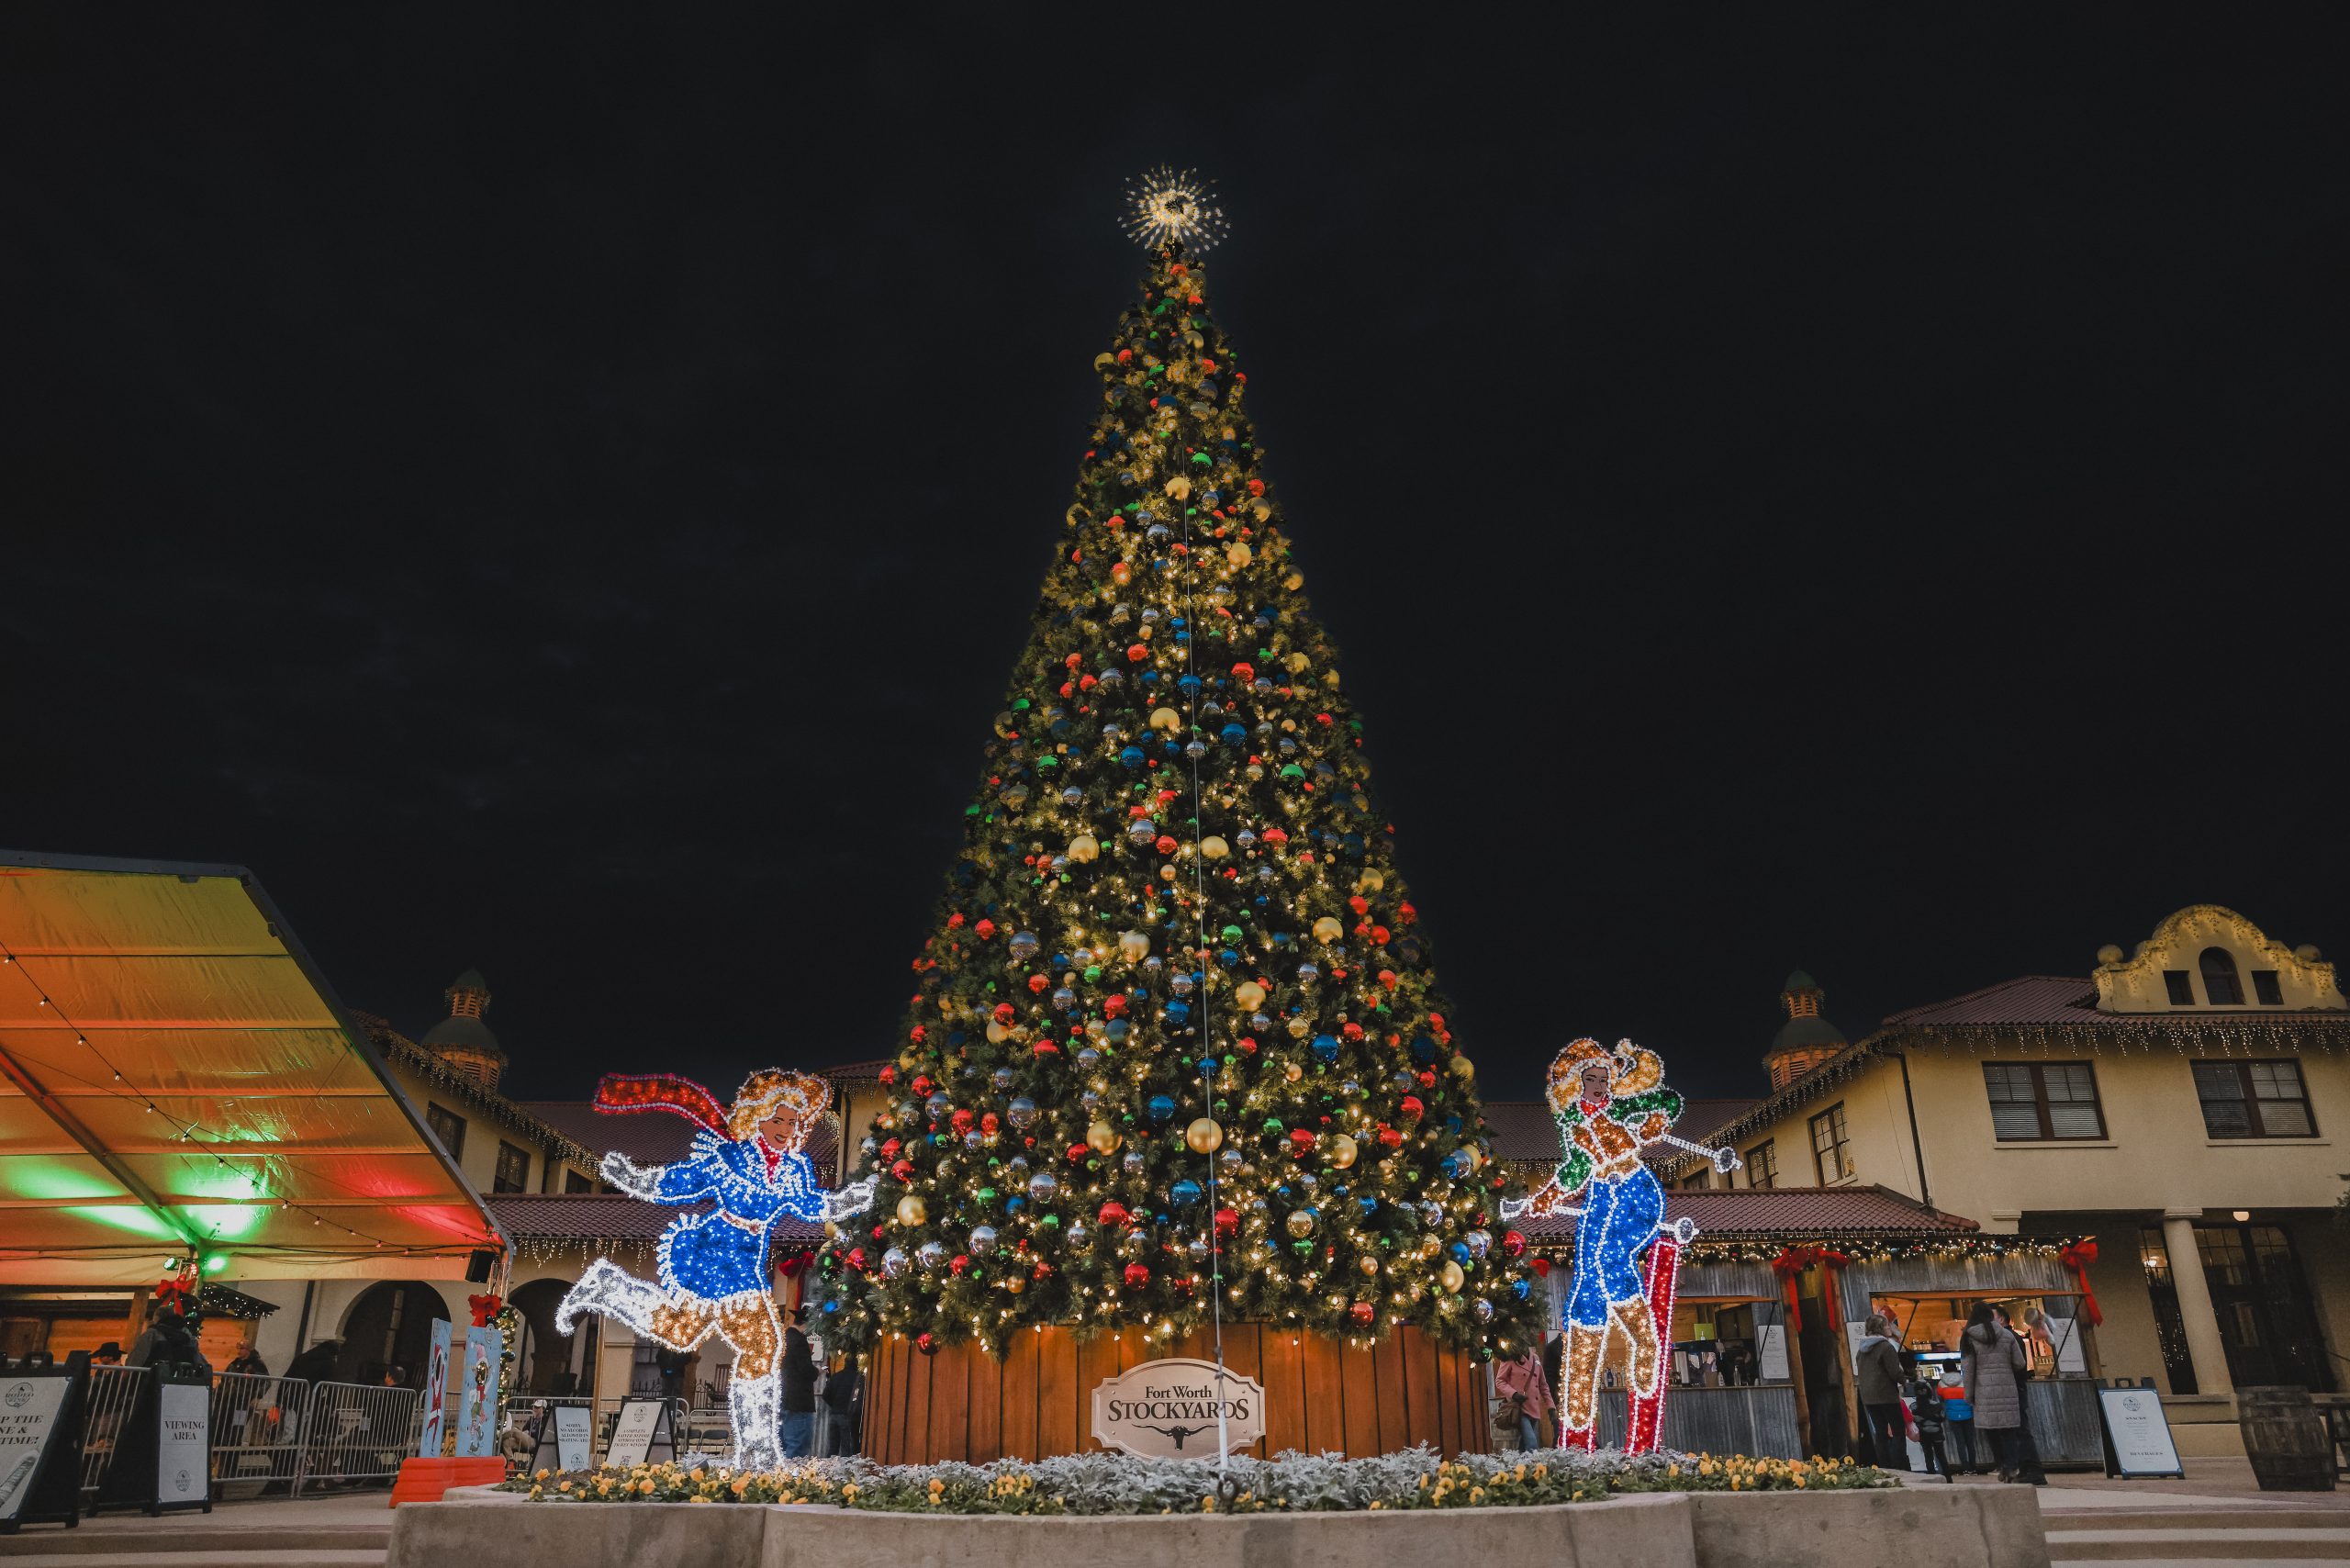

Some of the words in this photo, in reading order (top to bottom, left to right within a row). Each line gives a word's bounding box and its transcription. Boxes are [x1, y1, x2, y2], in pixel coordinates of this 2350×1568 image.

[1145, 1385, 1170, 1399] Fort
[1171, 1384, 1213, 1399] Worth
[1108, 1398, 1249, 1422] STOCKYARDS
[14, 1415, 44, 1424] THE
[164, 1420, 205, 1430] VIEWING
[172, 1431, 196, 1440] AREA
[0, 1436, 39, 1445] TIME!
